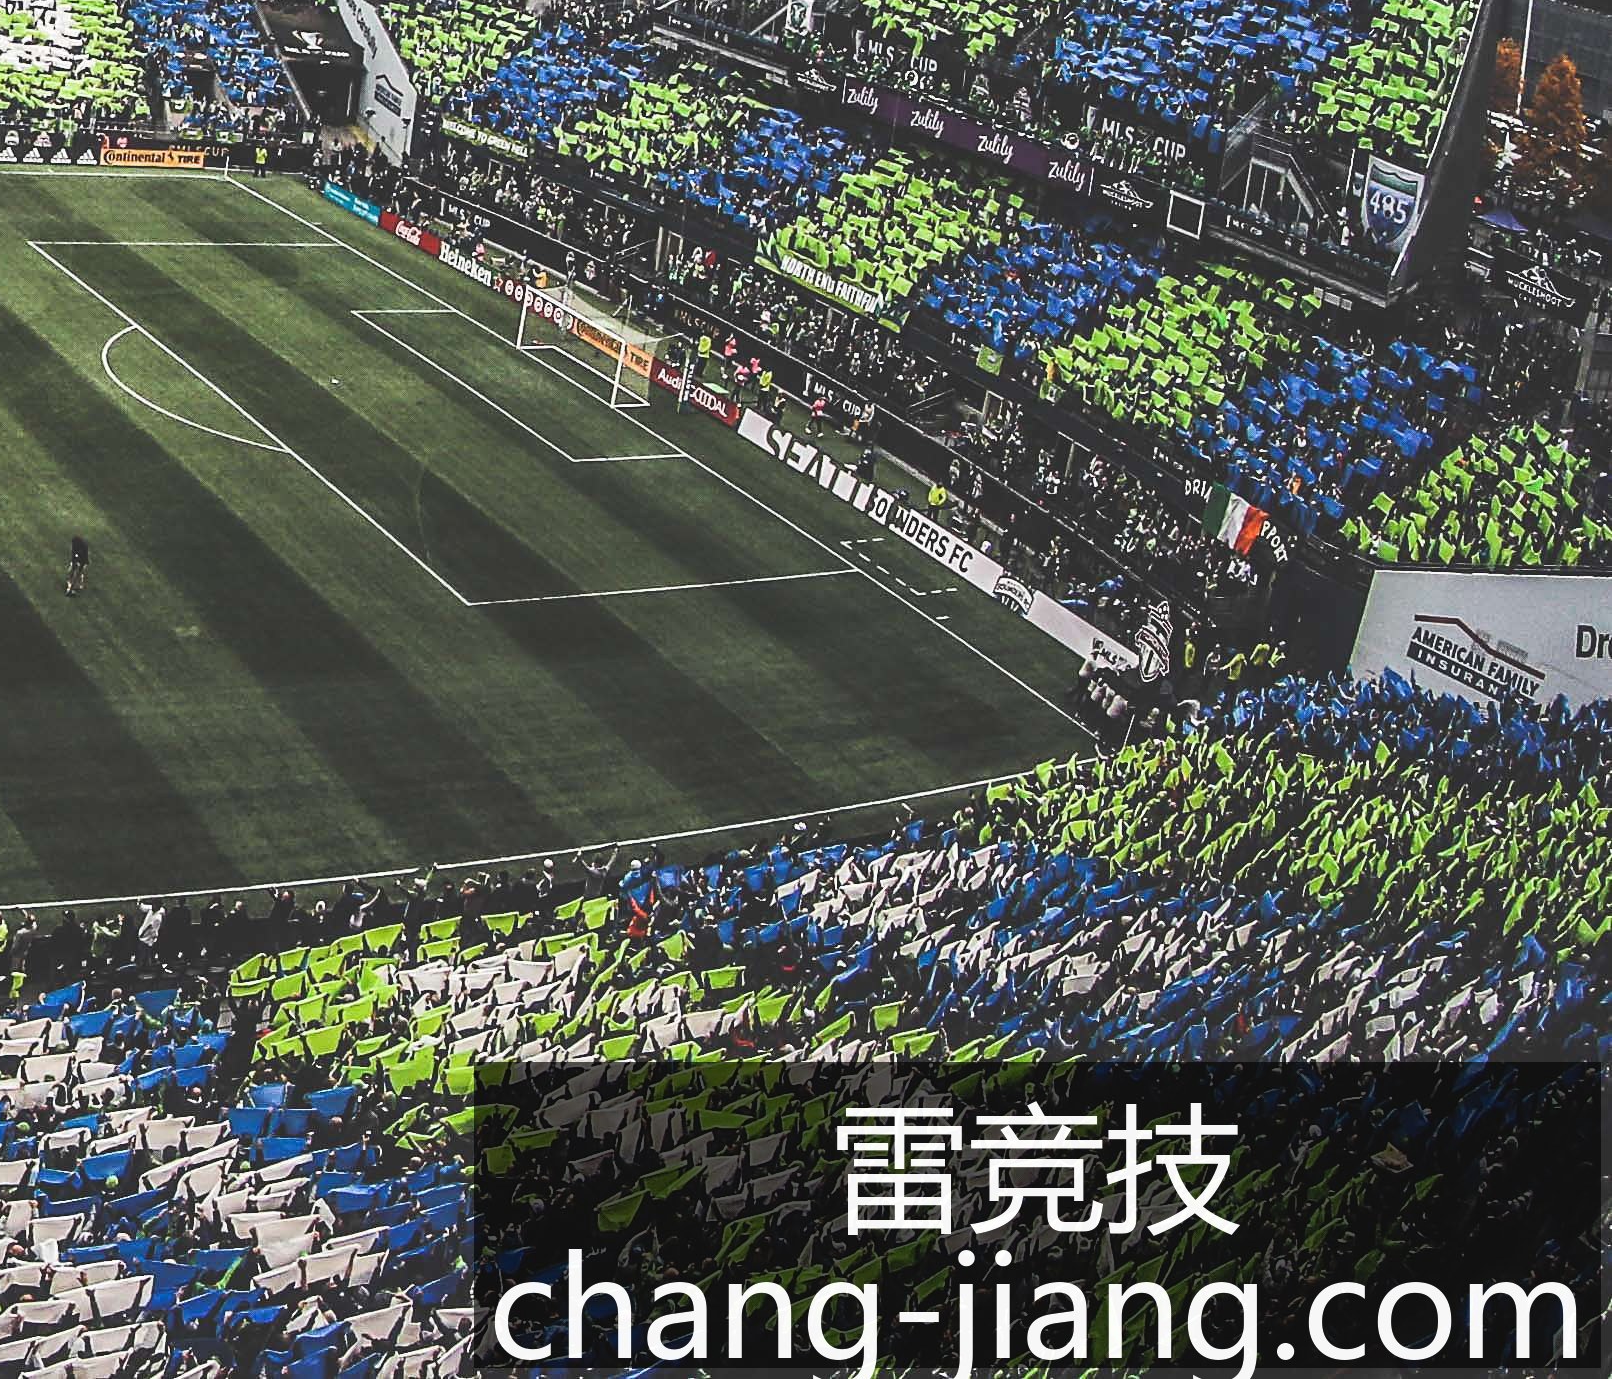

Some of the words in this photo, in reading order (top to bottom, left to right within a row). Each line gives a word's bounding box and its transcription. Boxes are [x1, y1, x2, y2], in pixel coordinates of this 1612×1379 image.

[1102, 118, 1134, 144] MLS
[1153, 137, 1185, 160] CUP
[103, 150, 165, 166] Continental
[177, 155, 200, 165] TIRE
[440, 241, 492, 287] Heineken
[781, 254, 814, 285] NORTH
[1507, 277, 1562, 308] MUCKLESHOOT
[629, 351, 650, 371] TIRE
[658, 369, 684, 390] Audi
[842, 399, 861, 417] CUP
[948, 543, 974, 573] FC
[1411, 626, 1487, 673] AMERICAN
[1487, 660, 1540, 698] FAMILY
[1417, 651, 1500, 696] INSURAN
